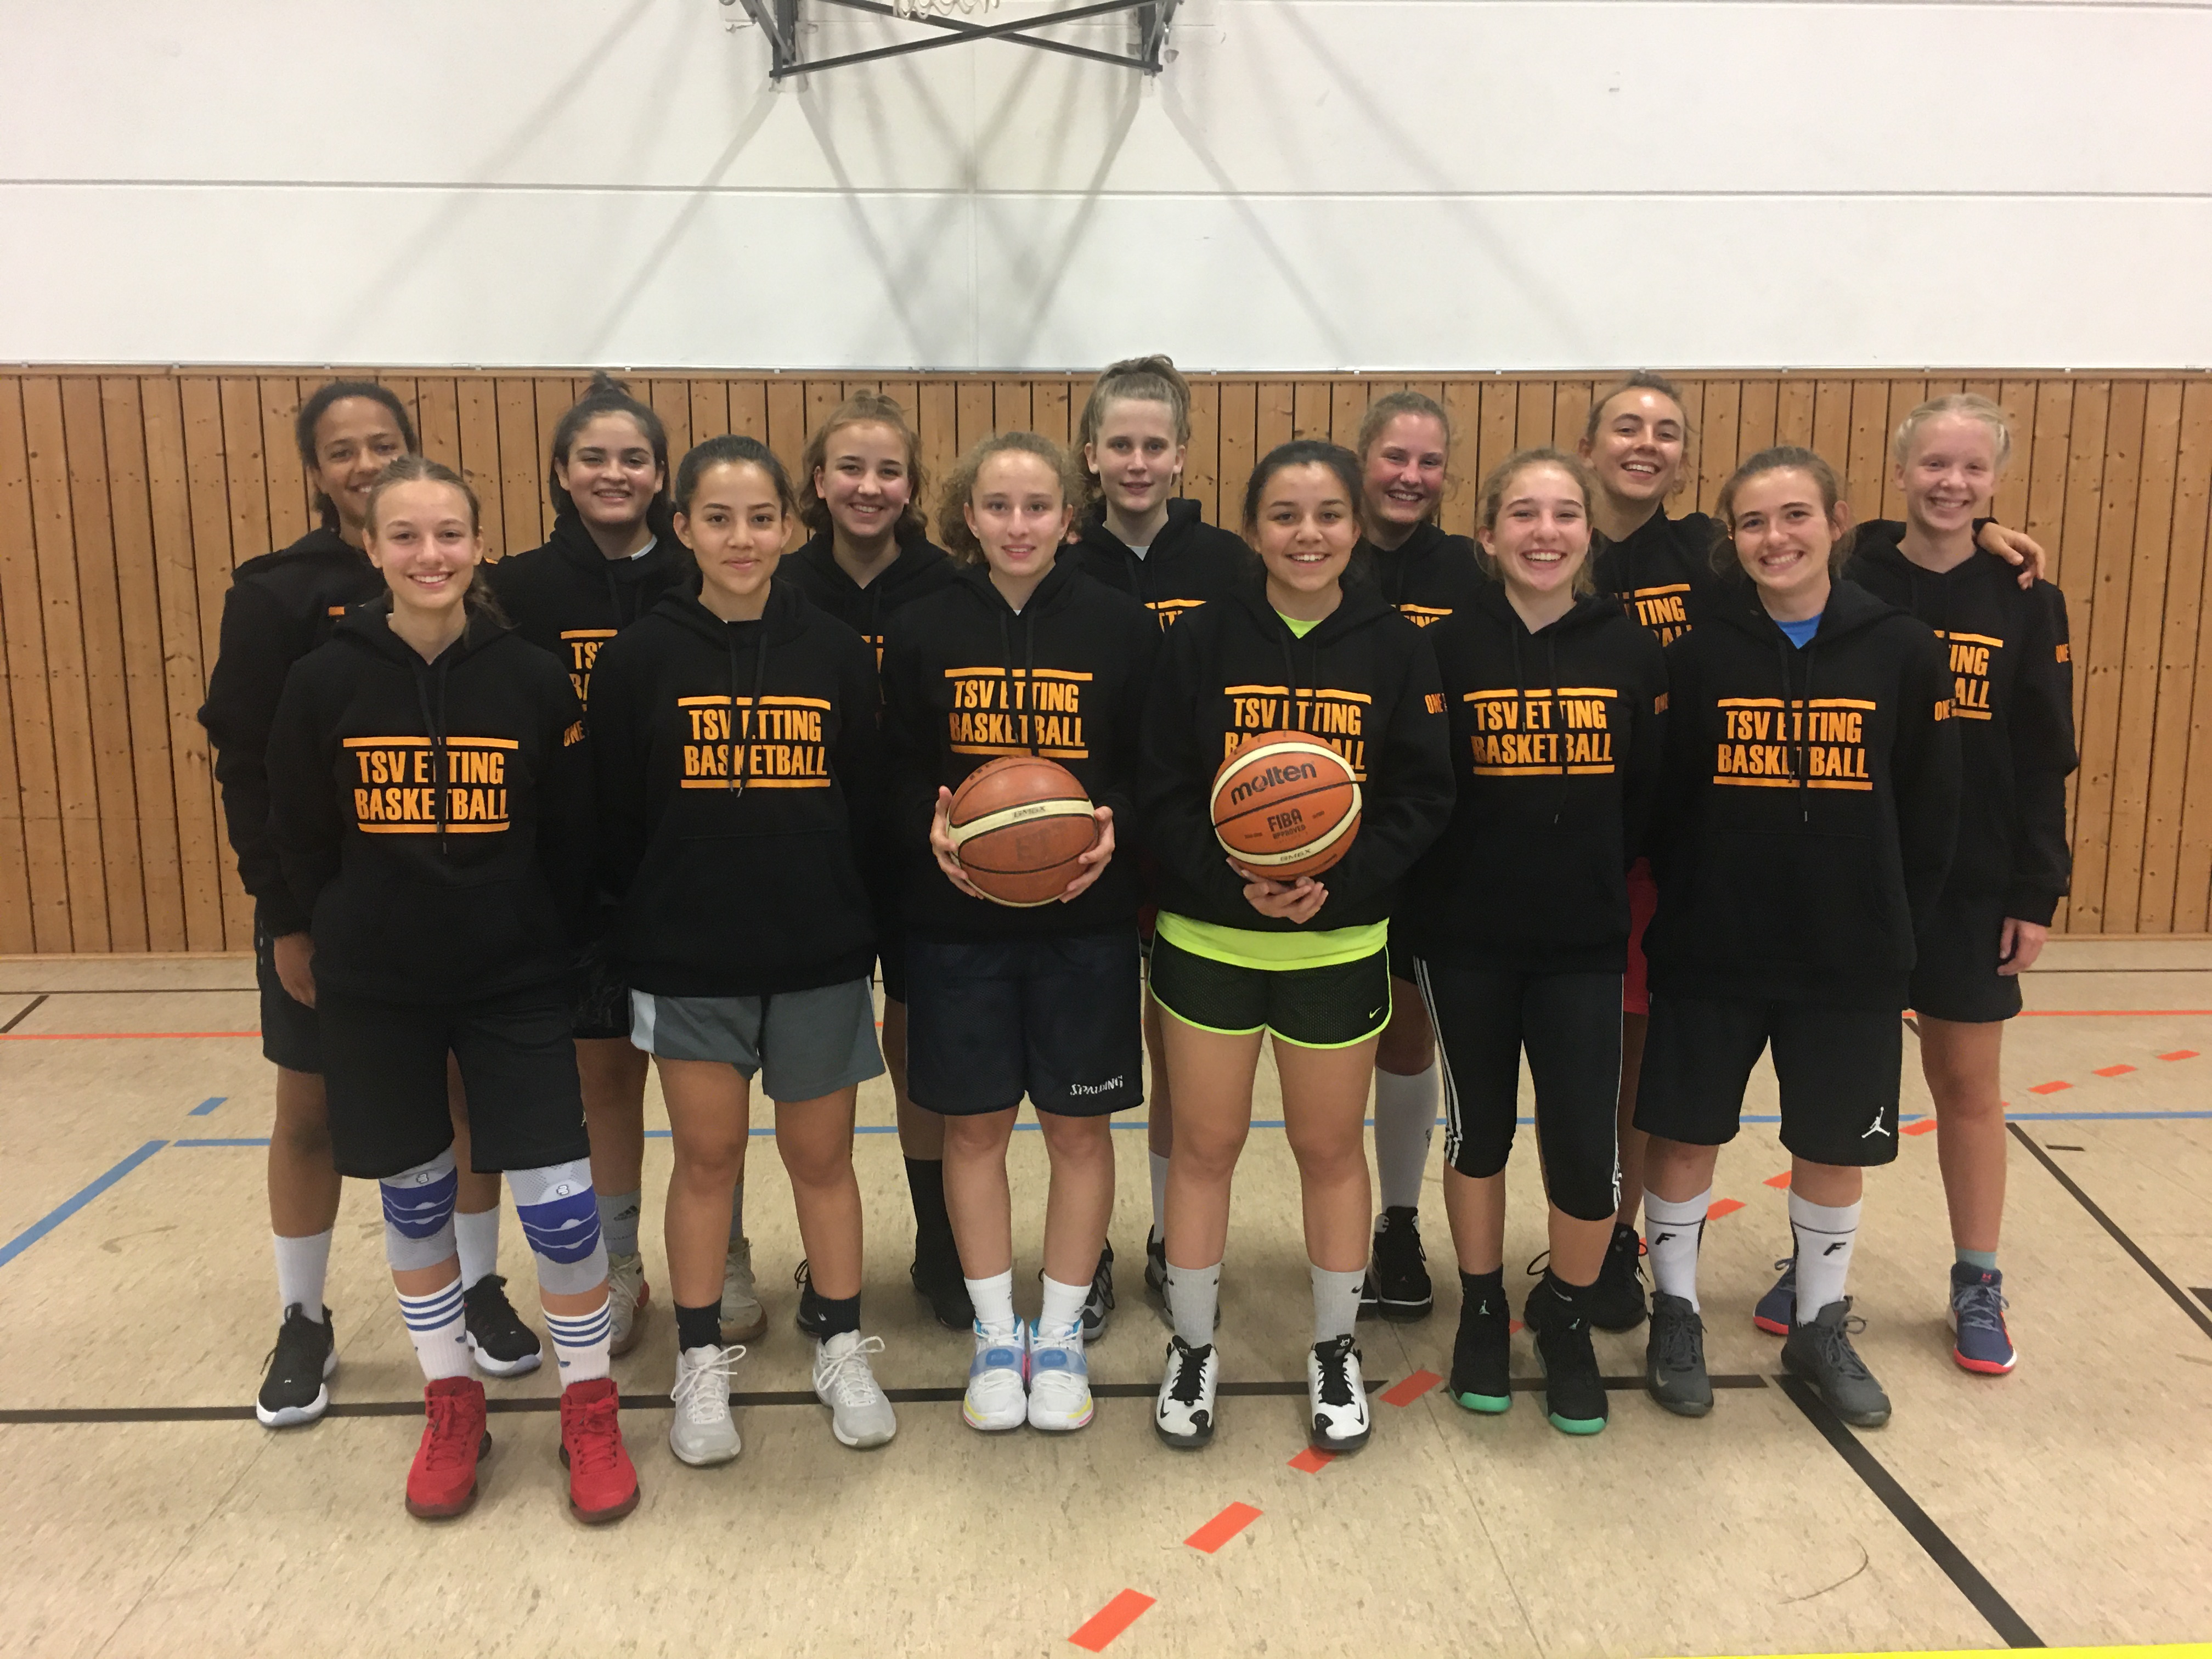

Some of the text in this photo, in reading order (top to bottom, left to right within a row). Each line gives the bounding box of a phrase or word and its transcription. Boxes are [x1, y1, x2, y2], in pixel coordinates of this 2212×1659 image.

[955, 680, 995, 709] TSV
[689, 709, 731, 741] TSV
[1234, 697, 1277, 729] TSV
[1474, 700, 1607, 731] TSV ETING
[1726, 710, 1771, 741] TSV
[356, 751, 406, 783] TSV
[1231, 763, 1317, 805] molten
[354, 787, 509, 821] BASKEBALL
[1267, 808, 1303, 832] FIBA
[1272, 824, 1306, 840] APPROVED
